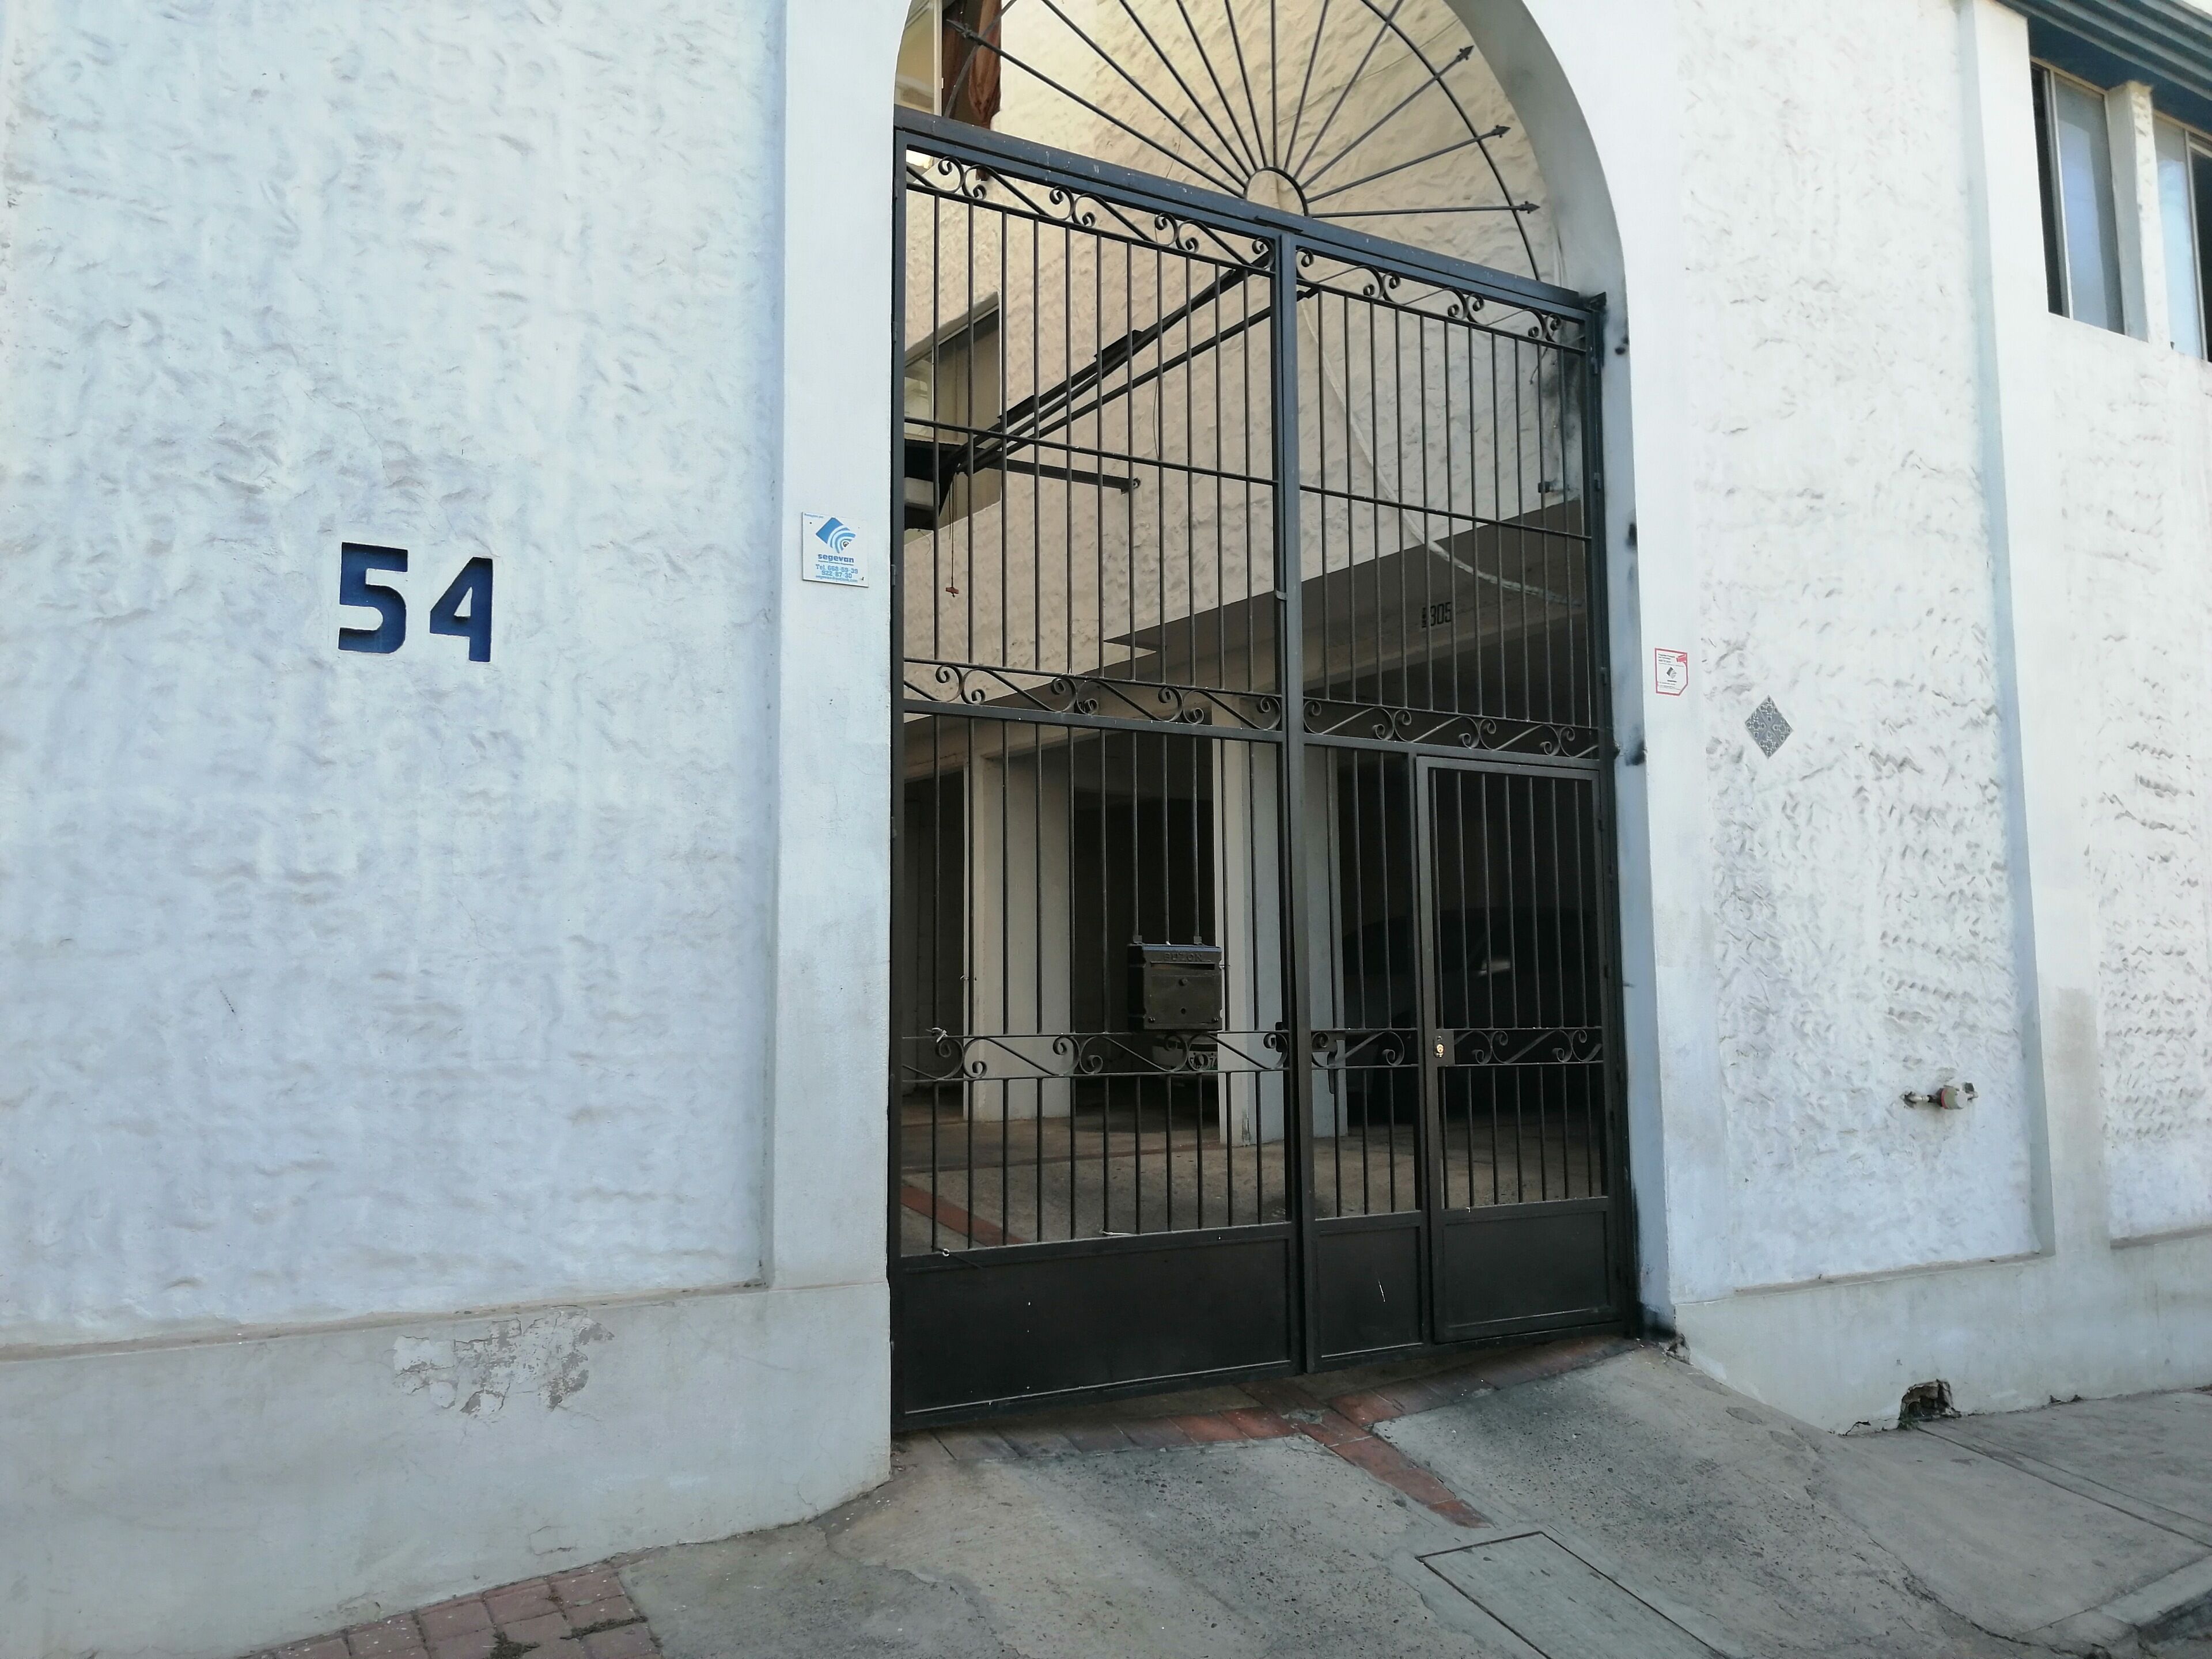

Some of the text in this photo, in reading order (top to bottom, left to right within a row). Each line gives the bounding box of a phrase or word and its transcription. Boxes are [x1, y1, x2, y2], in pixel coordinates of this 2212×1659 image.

[817, 554, 854, 563] segevan
[338, 542, 493, 662] 54
[1430, 602, 1452, 626] 305
